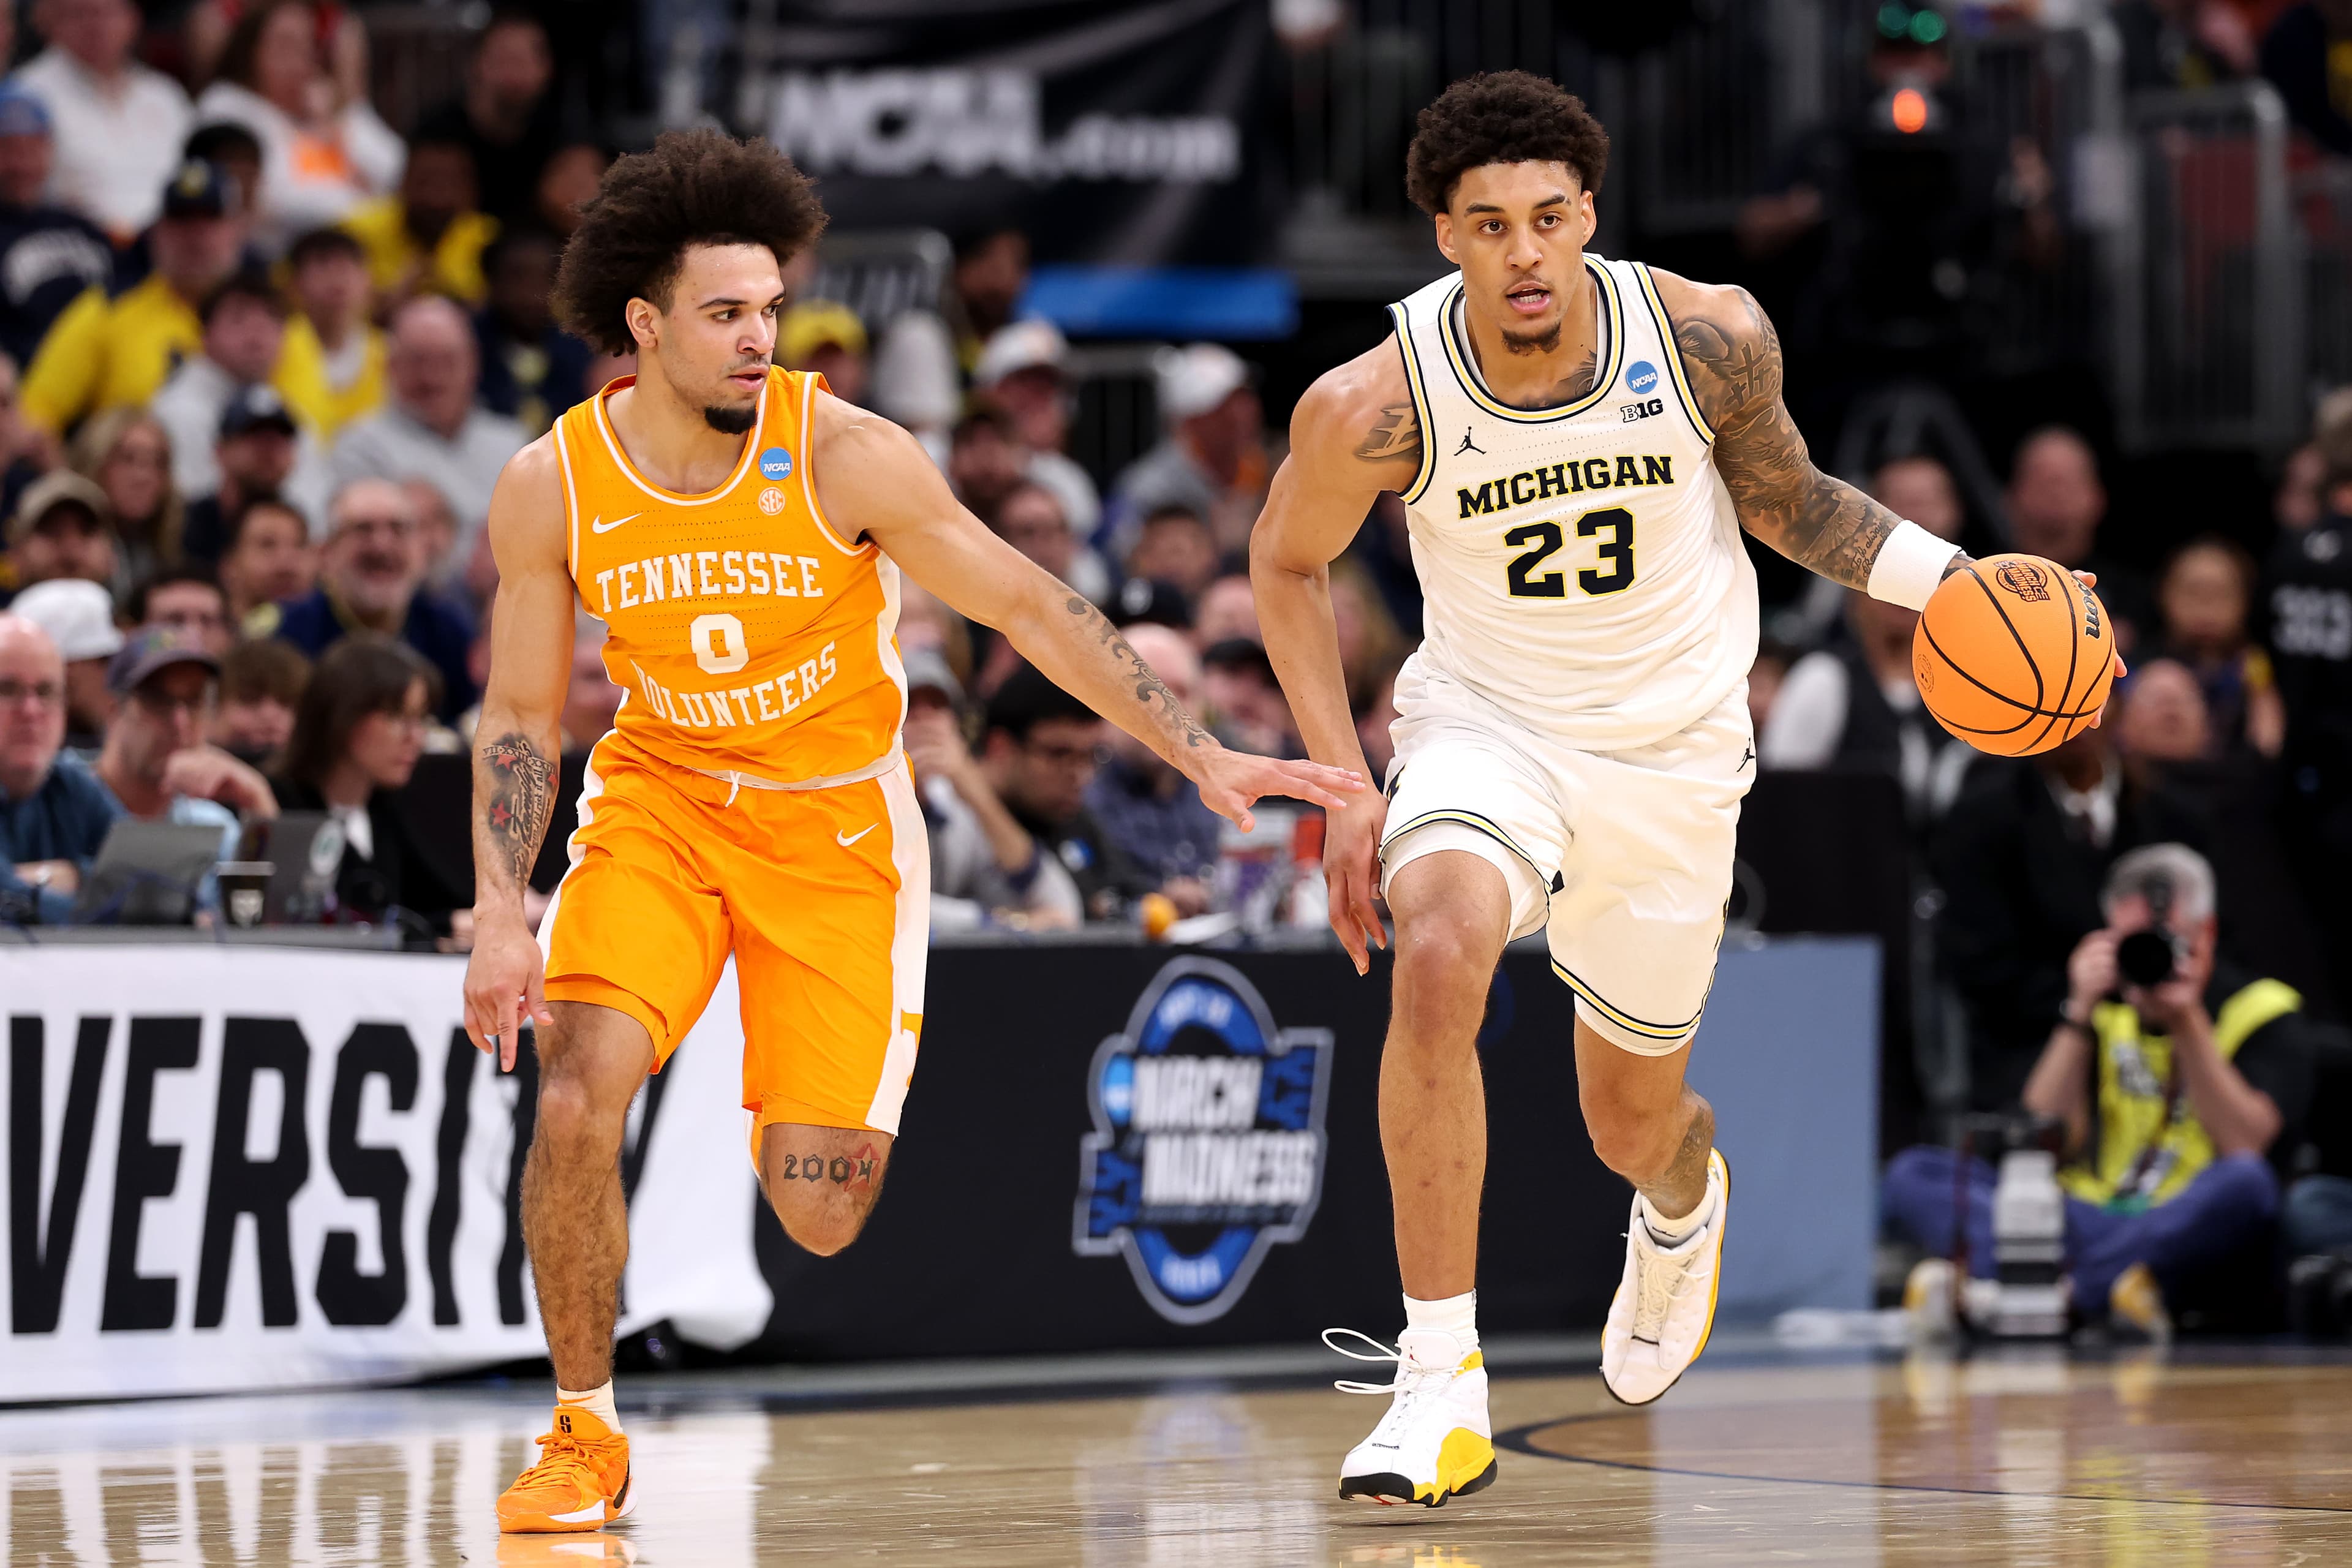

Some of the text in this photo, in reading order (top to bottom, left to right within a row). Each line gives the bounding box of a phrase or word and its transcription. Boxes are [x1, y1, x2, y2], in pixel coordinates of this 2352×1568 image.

[1632, 372, 1657, 388] NCAA
[764, 462, 790, 472] NCAA
[1456, 454, 1676, 519] MICHIGAN
[760, 489, 784, 513] SEC
[596, 551, 824, 613] TENNESSEE
[1502, 506, 1636, 600] 23
[2007, 567, 2037, 601] MADNESS
[690, 613, 750, 674] 0
[630, 640, 837, 728] VOLUNTEERS
[9, 1014, 682, 1333] VERSIT
[783, 1153, 873, 1185] 2004
